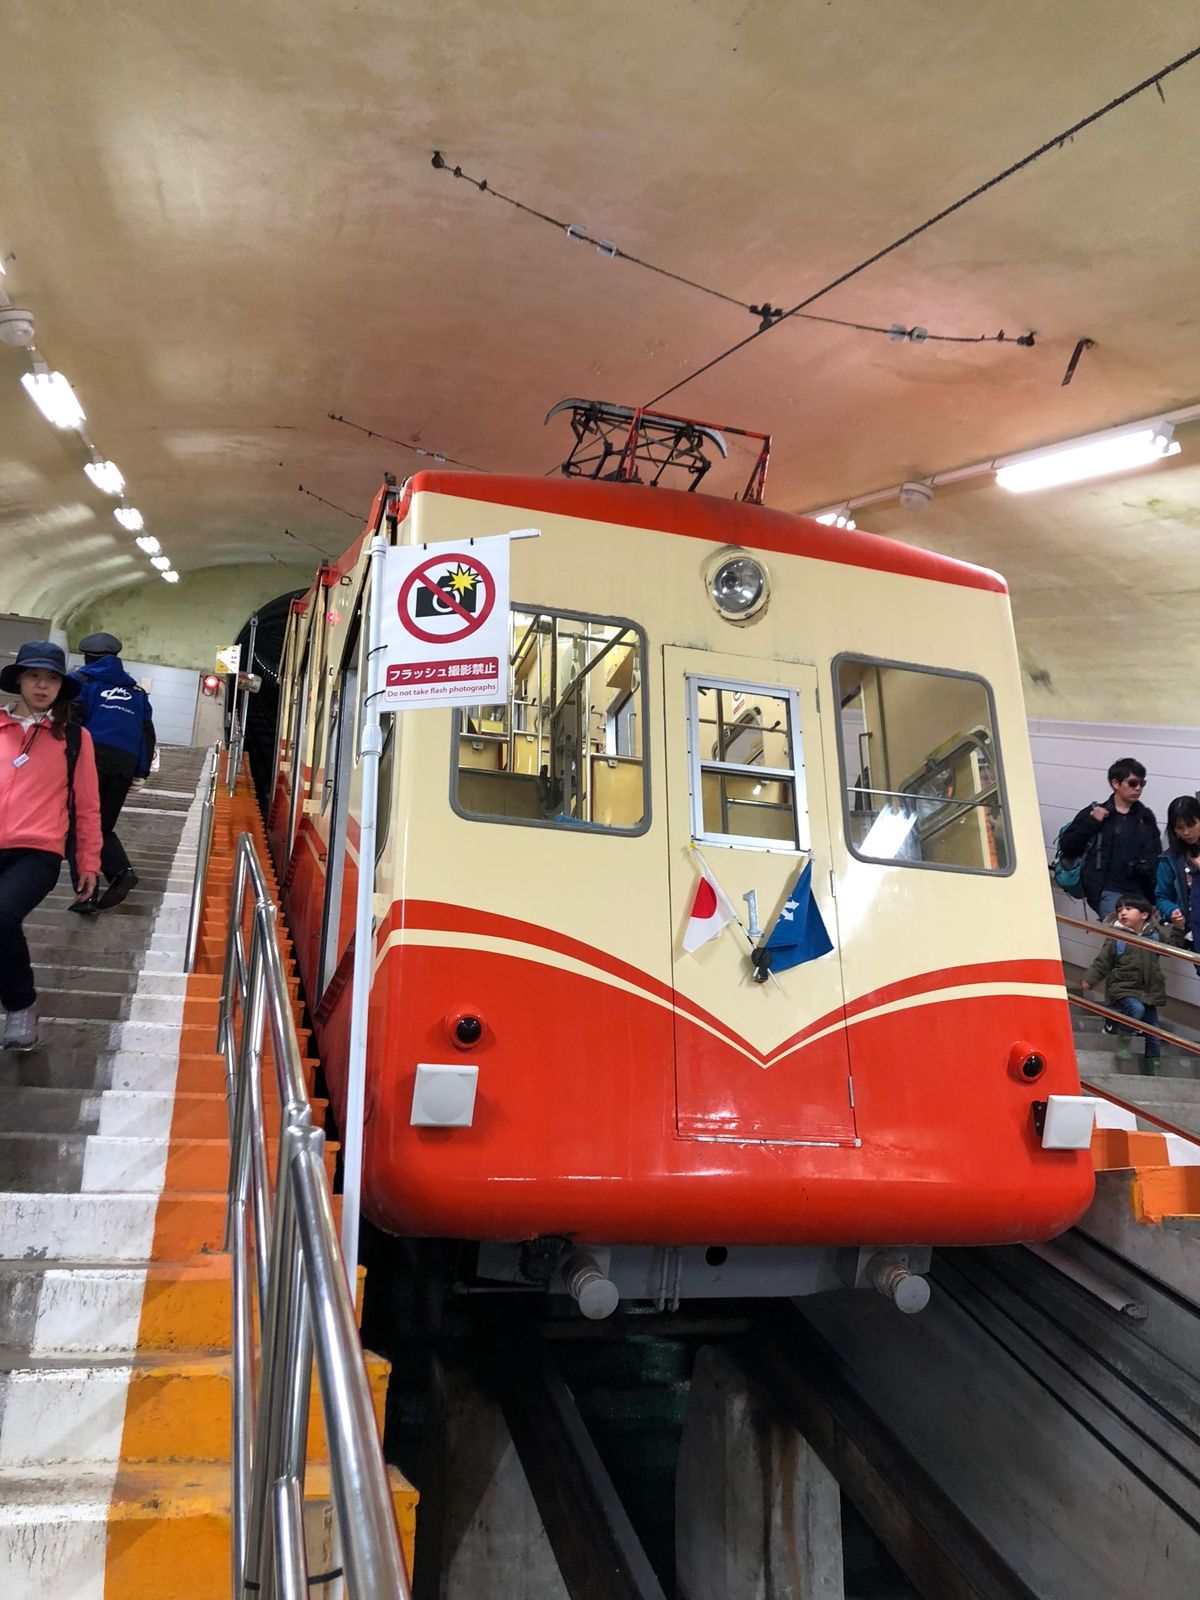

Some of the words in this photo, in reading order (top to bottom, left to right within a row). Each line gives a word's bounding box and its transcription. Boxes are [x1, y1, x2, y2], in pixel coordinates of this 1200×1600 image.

[389, 663, 497, 681] フラッシュ撮影禁止
[387, 690, 398, 698] Do
[399, 689, 412, 697] not
[413, 687, 429, 696] take
[430, 686, 448, 694] flash
[449, 683, 496, 694] photographs
[742, 890, 764, 938] 1
